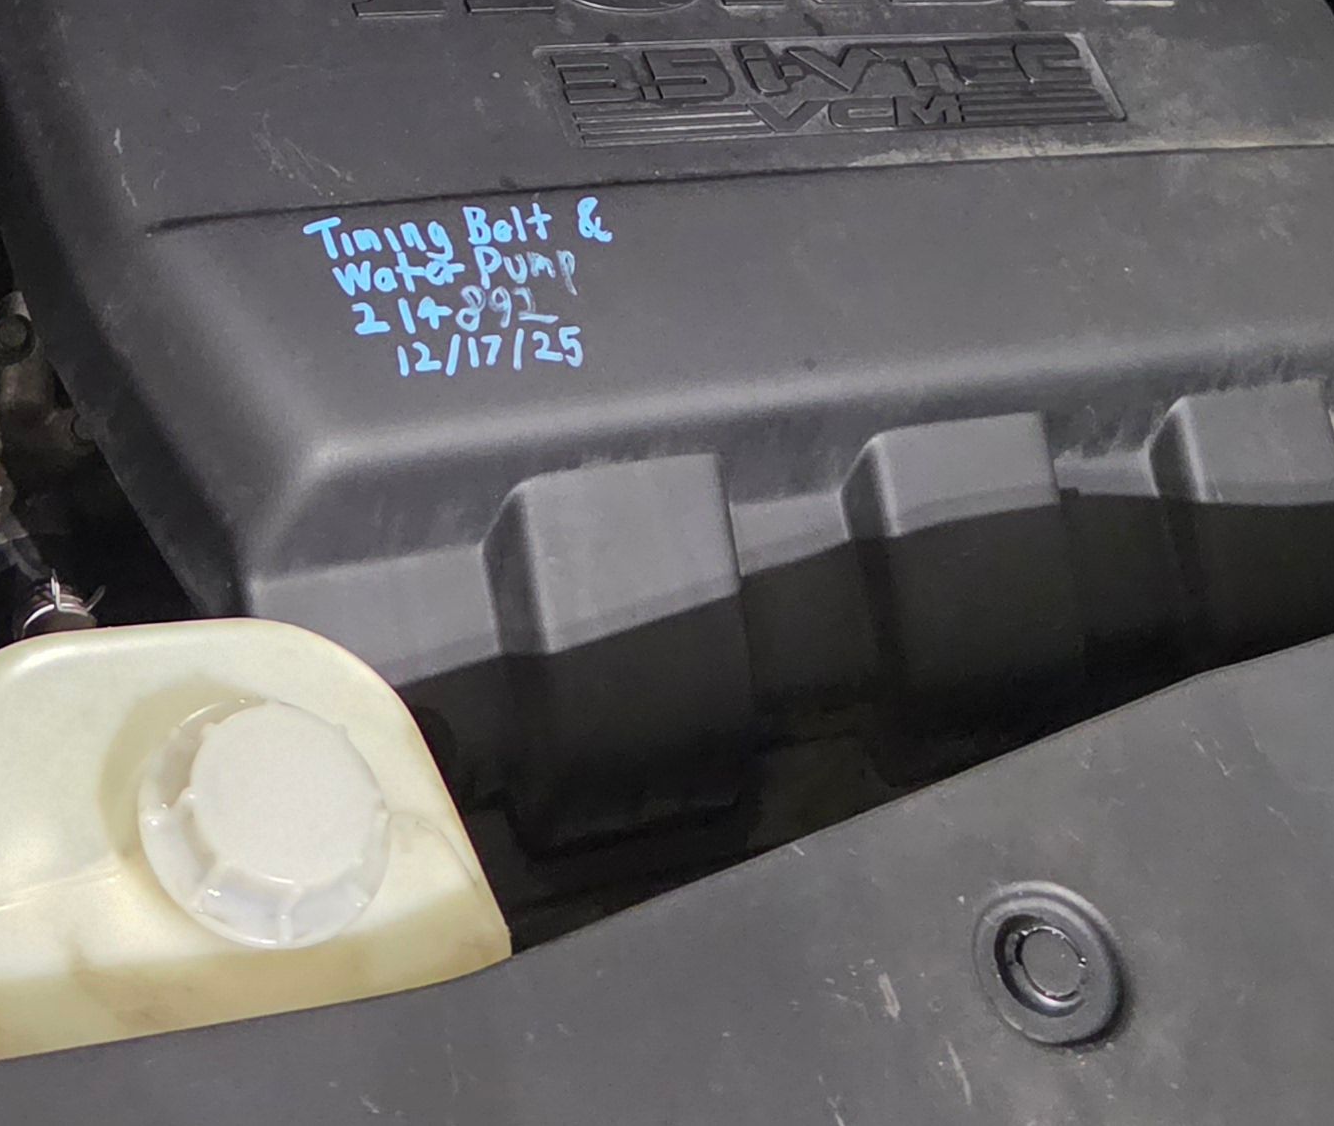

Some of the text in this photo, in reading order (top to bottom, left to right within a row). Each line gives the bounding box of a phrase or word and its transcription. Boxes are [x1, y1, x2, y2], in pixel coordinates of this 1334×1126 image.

[747, 93, 966, 133] VCM
[303, 217, 454, 262] Timing
[577, 196, 613, 242] &
[332, 245, 578, 296] Water Pump
[397, 325, 583, 376] 12/17/25
